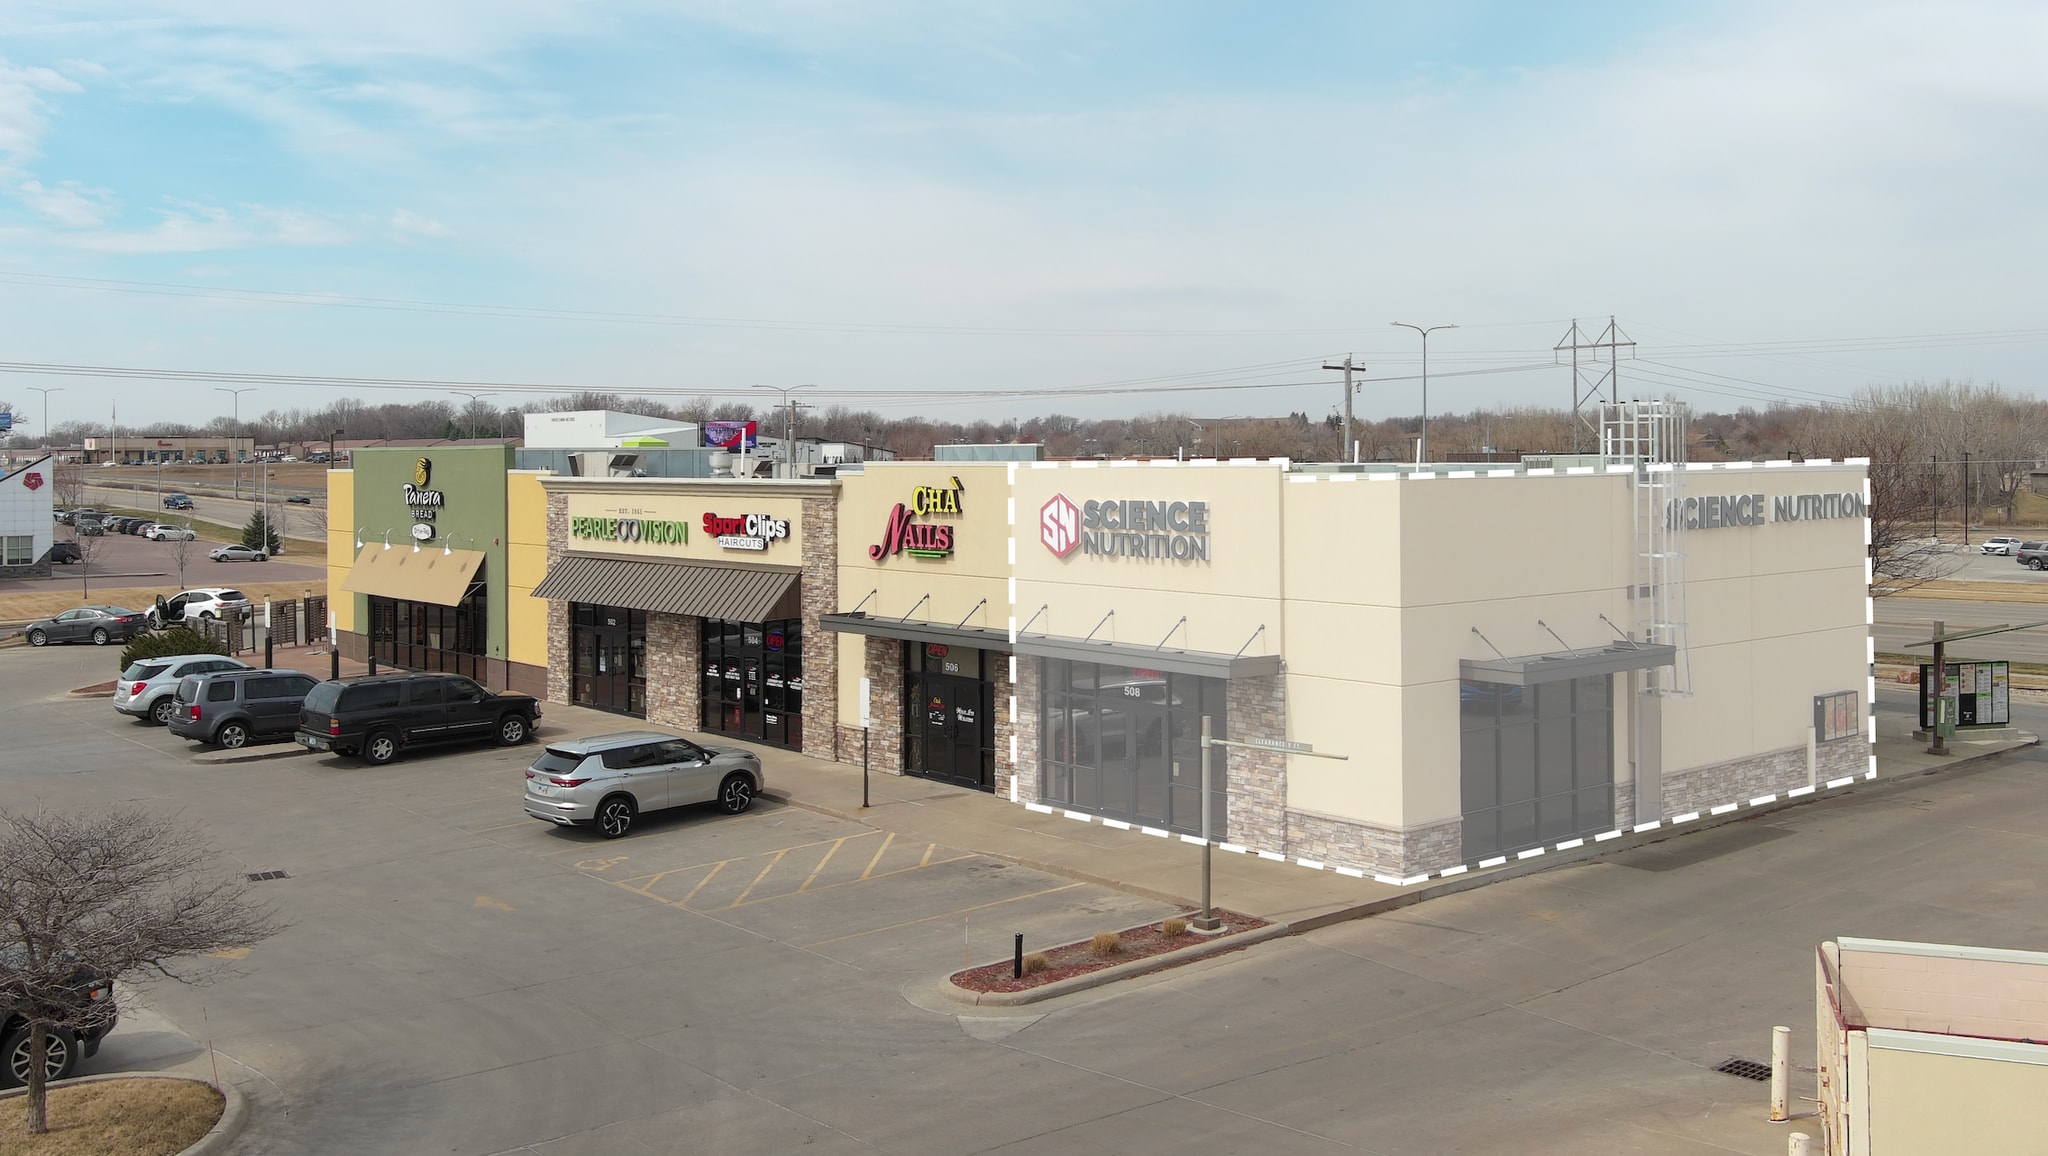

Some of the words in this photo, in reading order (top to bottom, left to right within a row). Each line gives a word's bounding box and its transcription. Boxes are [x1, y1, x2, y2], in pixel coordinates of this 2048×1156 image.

[402, 483, 442, 506] Panera
[411, 509, 433, 519] BREAD
[1083, 499, 1209, 533] SCIENCE
[1666, 494, 1765, 531] SCIENCE
[1773, 492, 1867, 523] NUTRITION
[571, 516, 617, 540] PEARLE
[639, 519, 688, 545] VISION
[718, 537, 763, 548] HAIRCUTS
[1083, 532, 1209, 561] NUTRITION
[766, 634, 784, 648] OPEN
[928, 643, 948, 657] OPEN
[945, 662, 959, 672] 506
[1124, 686, 1141, 698] 508
[1255, 738, 1285, 748] CLEARANCE
